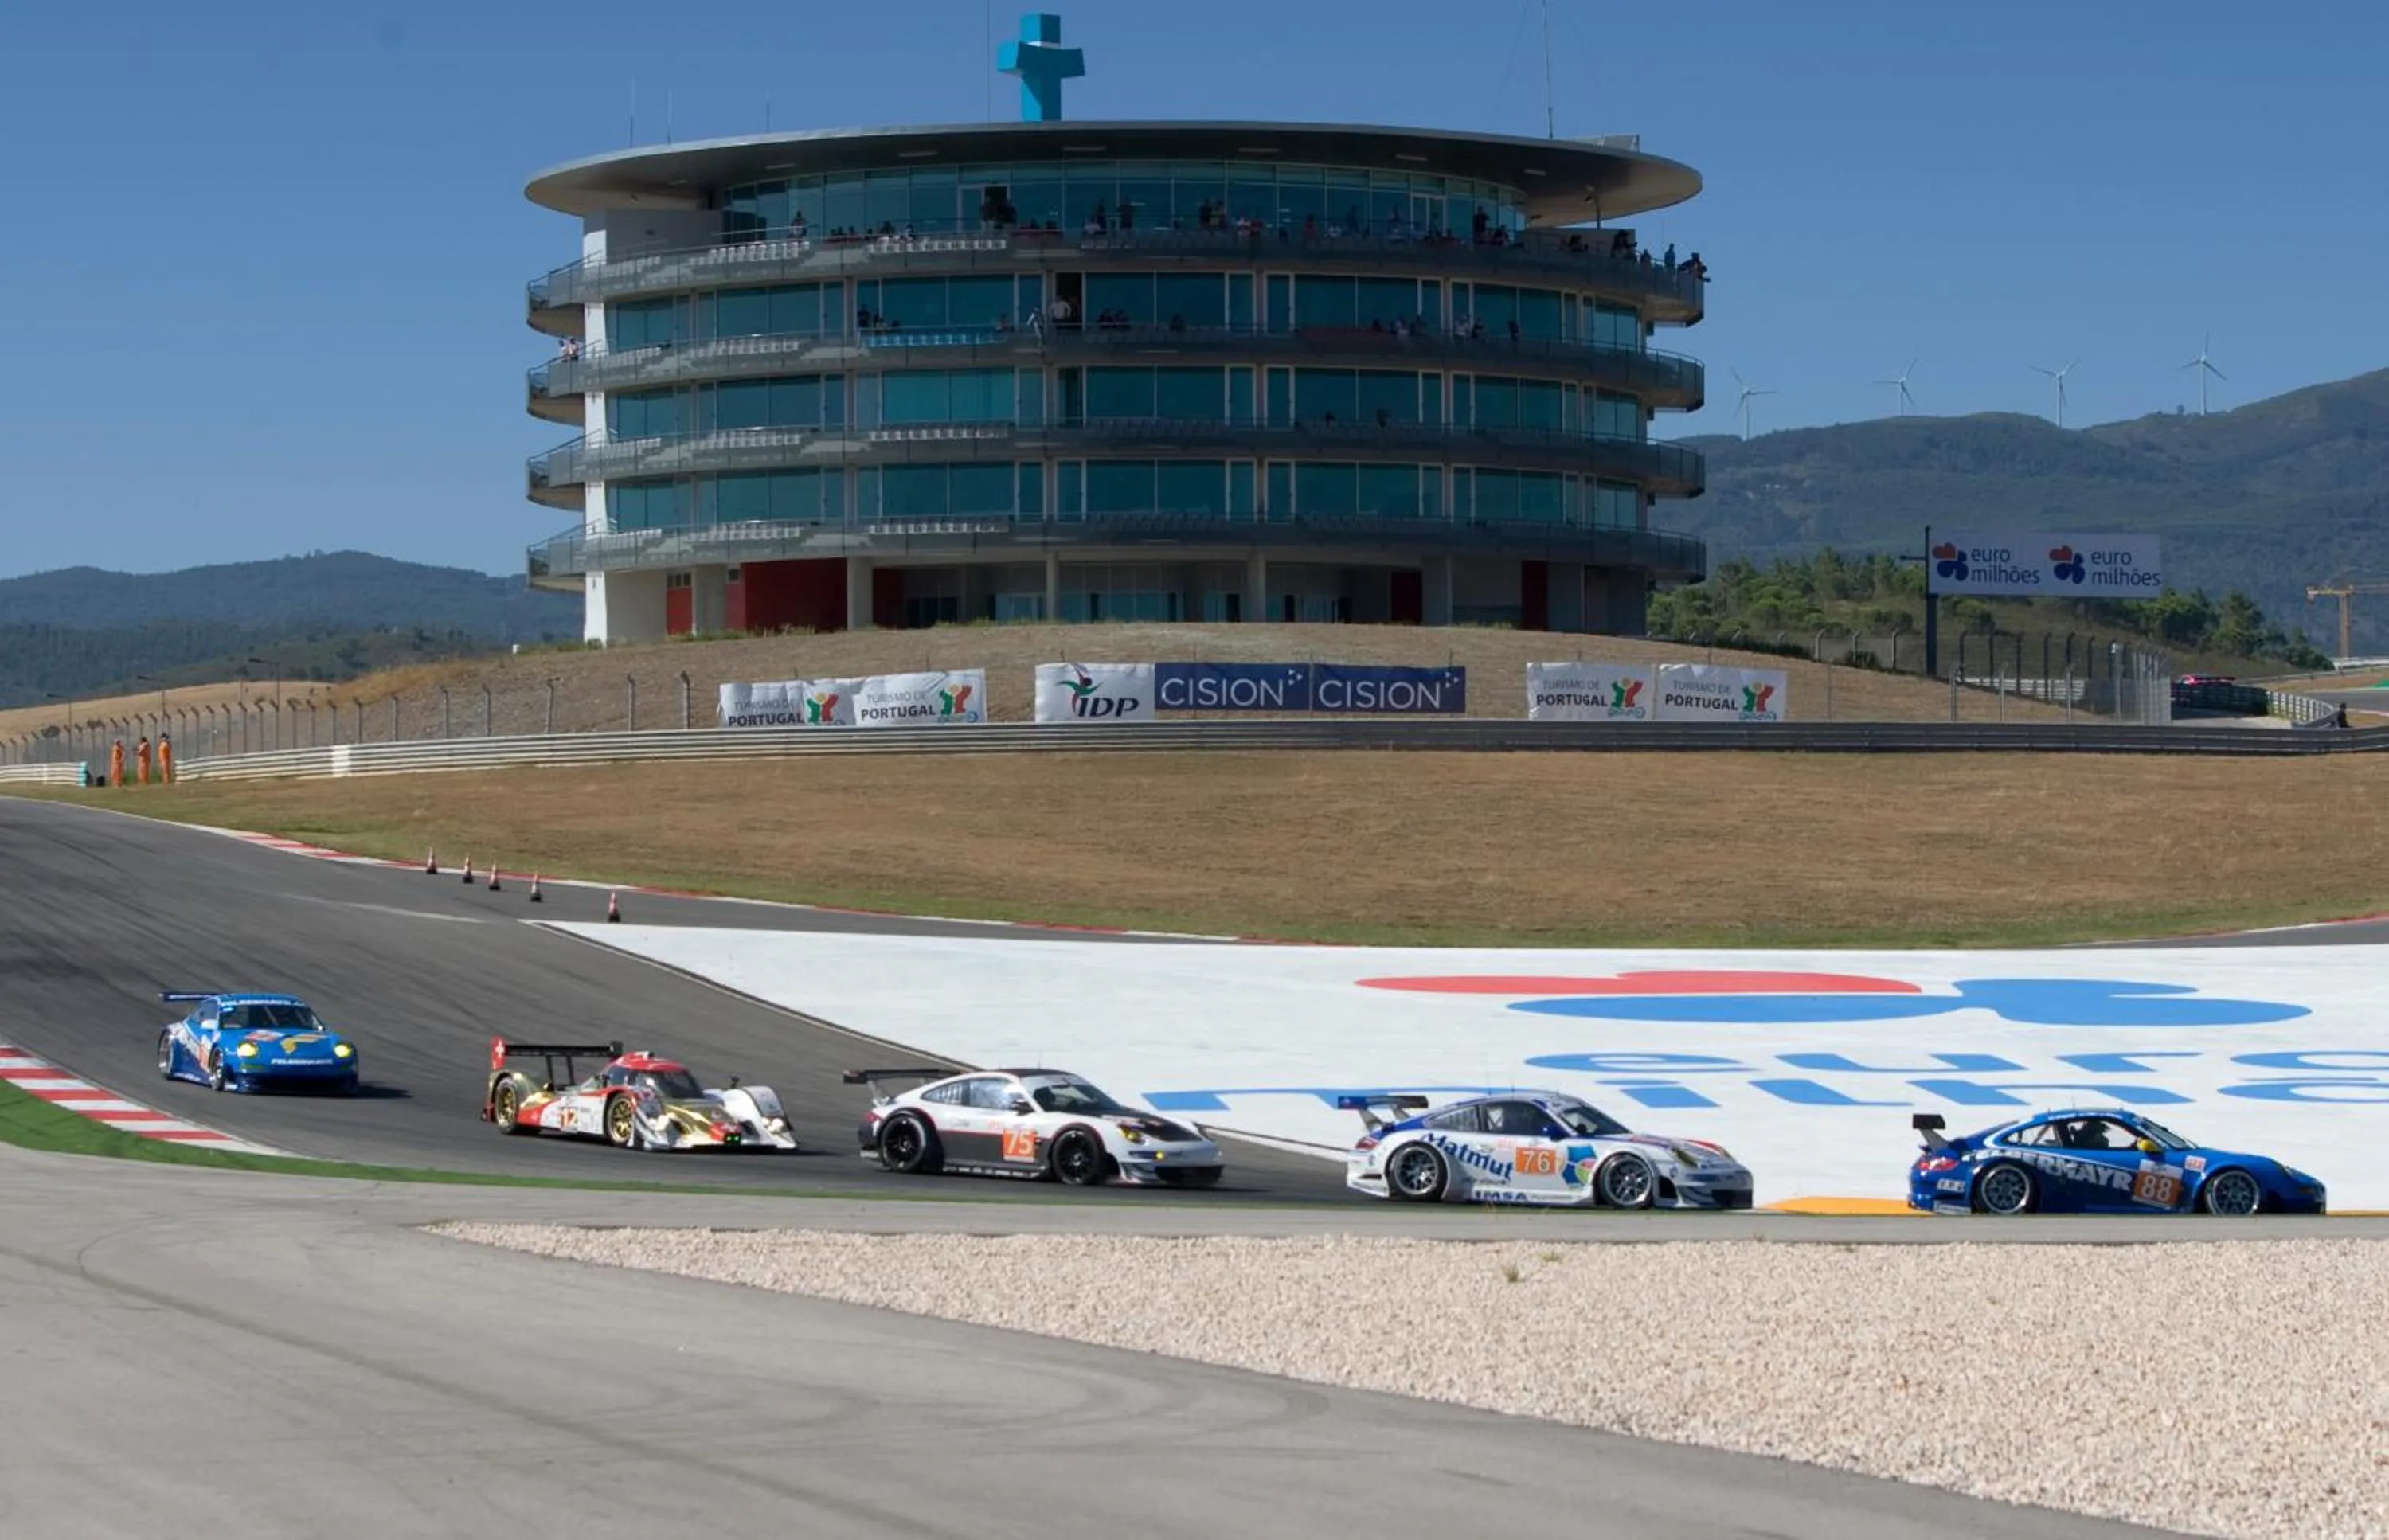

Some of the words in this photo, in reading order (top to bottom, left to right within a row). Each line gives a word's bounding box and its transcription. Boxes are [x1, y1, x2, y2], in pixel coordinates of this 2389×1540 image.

[1971, 548, 2011, 563] euro
[2091, 549, 2132, 565] euro
[1971, 565, 2039, 584] milhões
[2092, 567, 2161, 587] milhões
[1161, 678, 1283, 706] CISION
[1319, 680, 1440, 709] CISION
[1536, 694, 1609, 708] PORTUGAL
[1665, 694, 1739, 710] PORTUGAL
[861, 704, 936, 720] PORTUGAL
[1078, 697, 1140, 718] IDP
[729, 713, 804, 727] PORTUGAL
[1007, 1131, 1033, 1155] 75
[1421, 1132, 1514, 1182] Matmut
[1522, 1151, 1550, 1173] 76
[2141, 1175, 2173, 1202] 88
